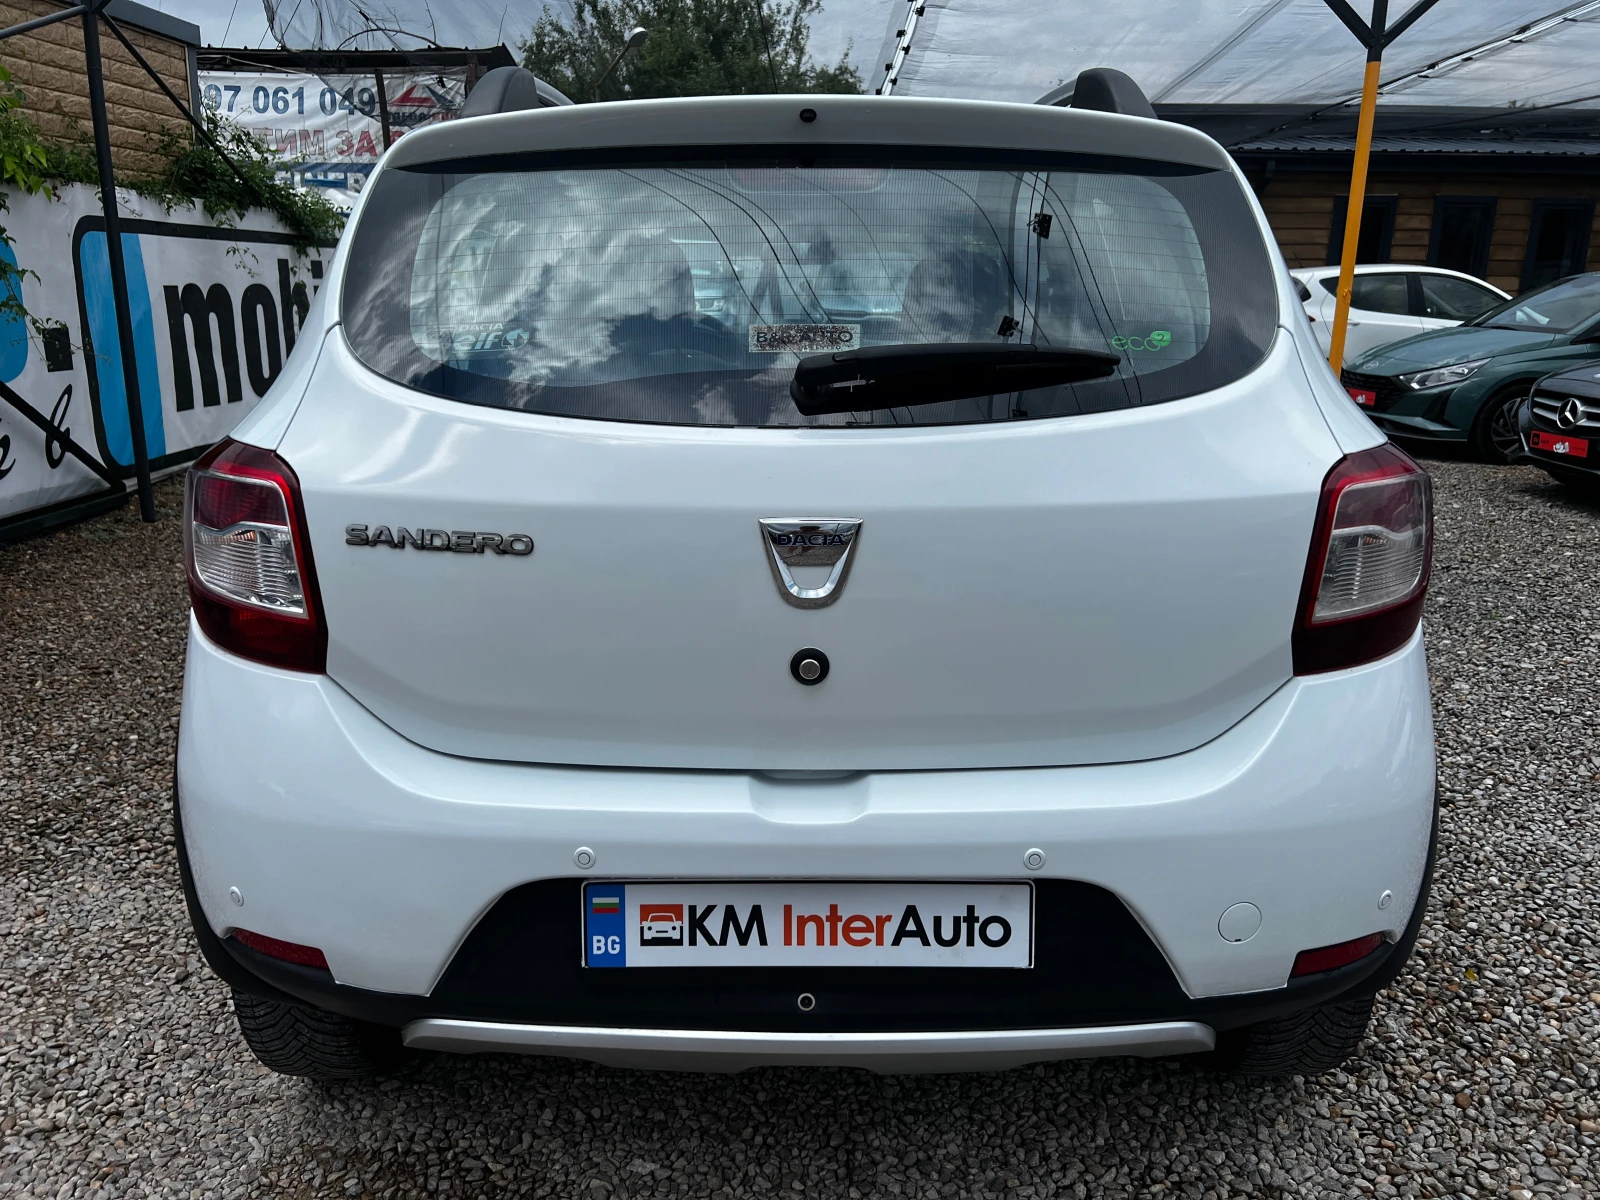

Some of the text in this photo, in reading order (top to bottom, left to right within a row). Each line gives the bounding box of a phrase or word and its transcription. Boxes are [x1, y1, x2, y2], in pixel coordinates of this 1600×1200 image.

[252, 86, 304, 115] 061
[319, 87, 376, 116] 049
[336, 130, 377, 156] ЗА
[460, 322, 504, 332] DACIA
[453, 331, 503, 351] elf
[345, 523, 535, 556] SANDERO
[776, 533, 845, 548] DACIA
[688, 903, 1013, 948] KM InterAuto
[592, 935, 621, 955] BG
